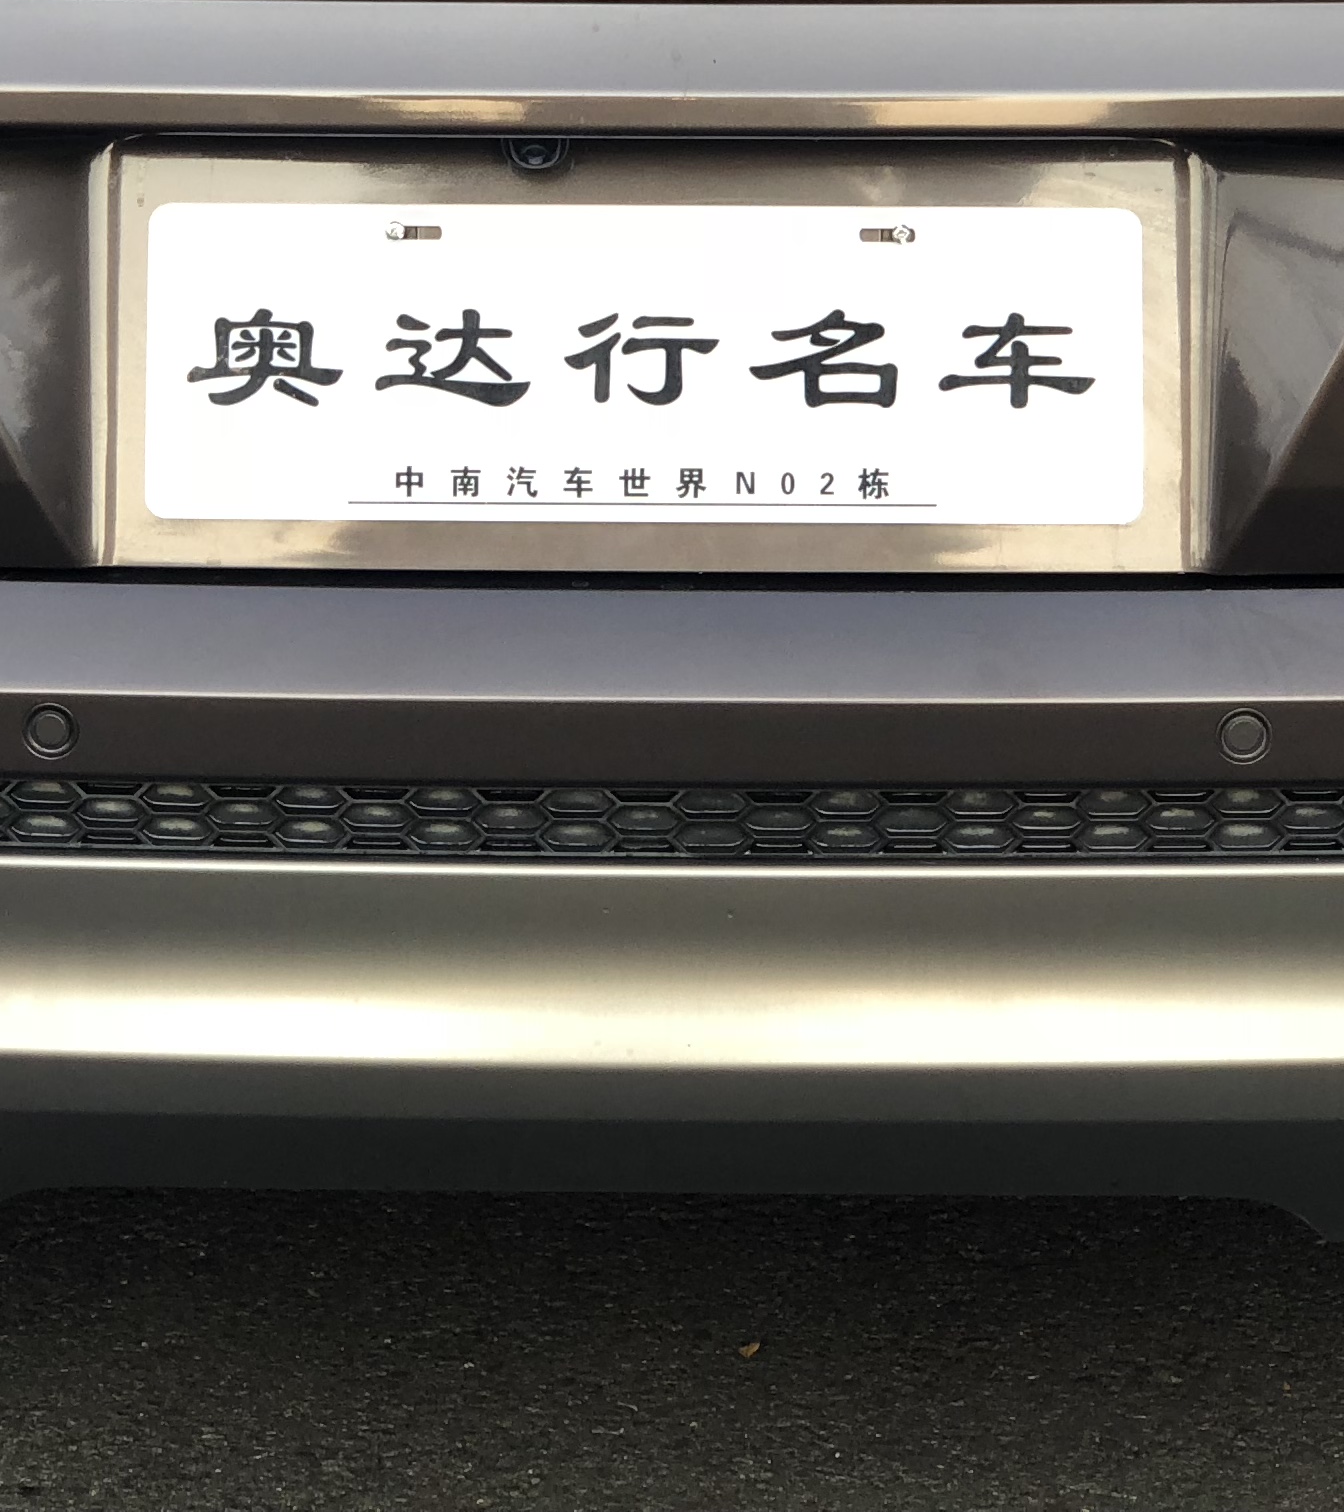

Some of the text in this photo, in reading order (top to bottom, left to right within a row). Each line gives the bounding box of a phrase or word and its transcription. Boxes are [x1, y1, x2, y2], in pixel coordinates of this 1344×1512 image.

[186, 308, 1096, 409] 奥达行名车
